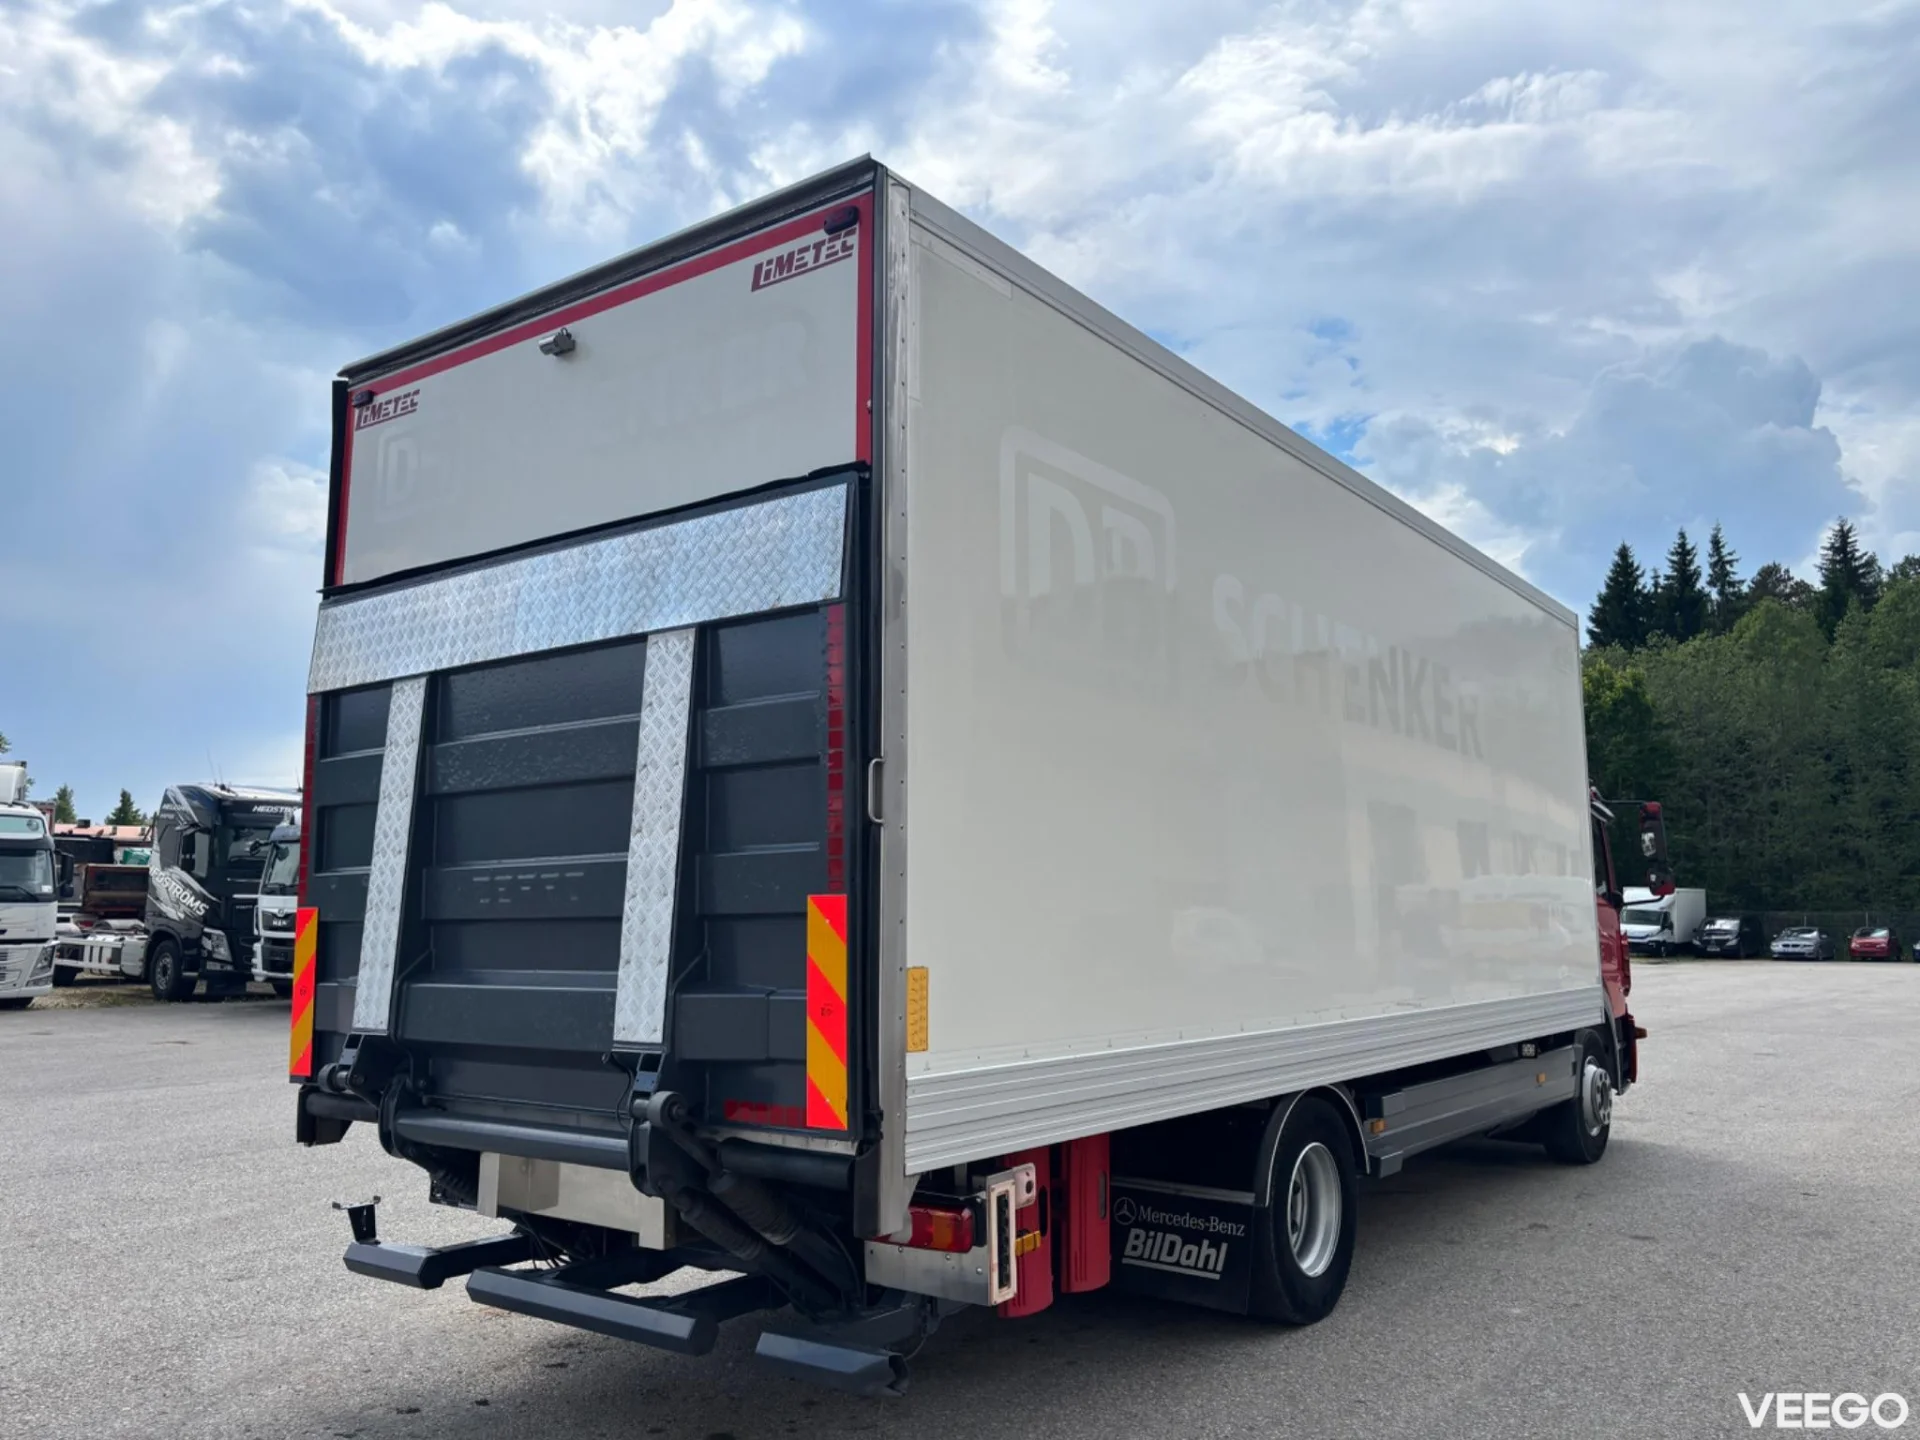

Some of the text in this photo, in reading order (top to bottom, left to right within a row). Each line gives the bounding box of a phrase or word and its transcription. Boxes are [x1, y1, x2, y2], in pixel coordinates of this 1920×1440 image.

[1212, 573, 1484, 760] SCHENKER
[1138, 1205, 1246, 1237] Mercedes-Benz
[1123, 1227, 1229, 1273] BilDahl
